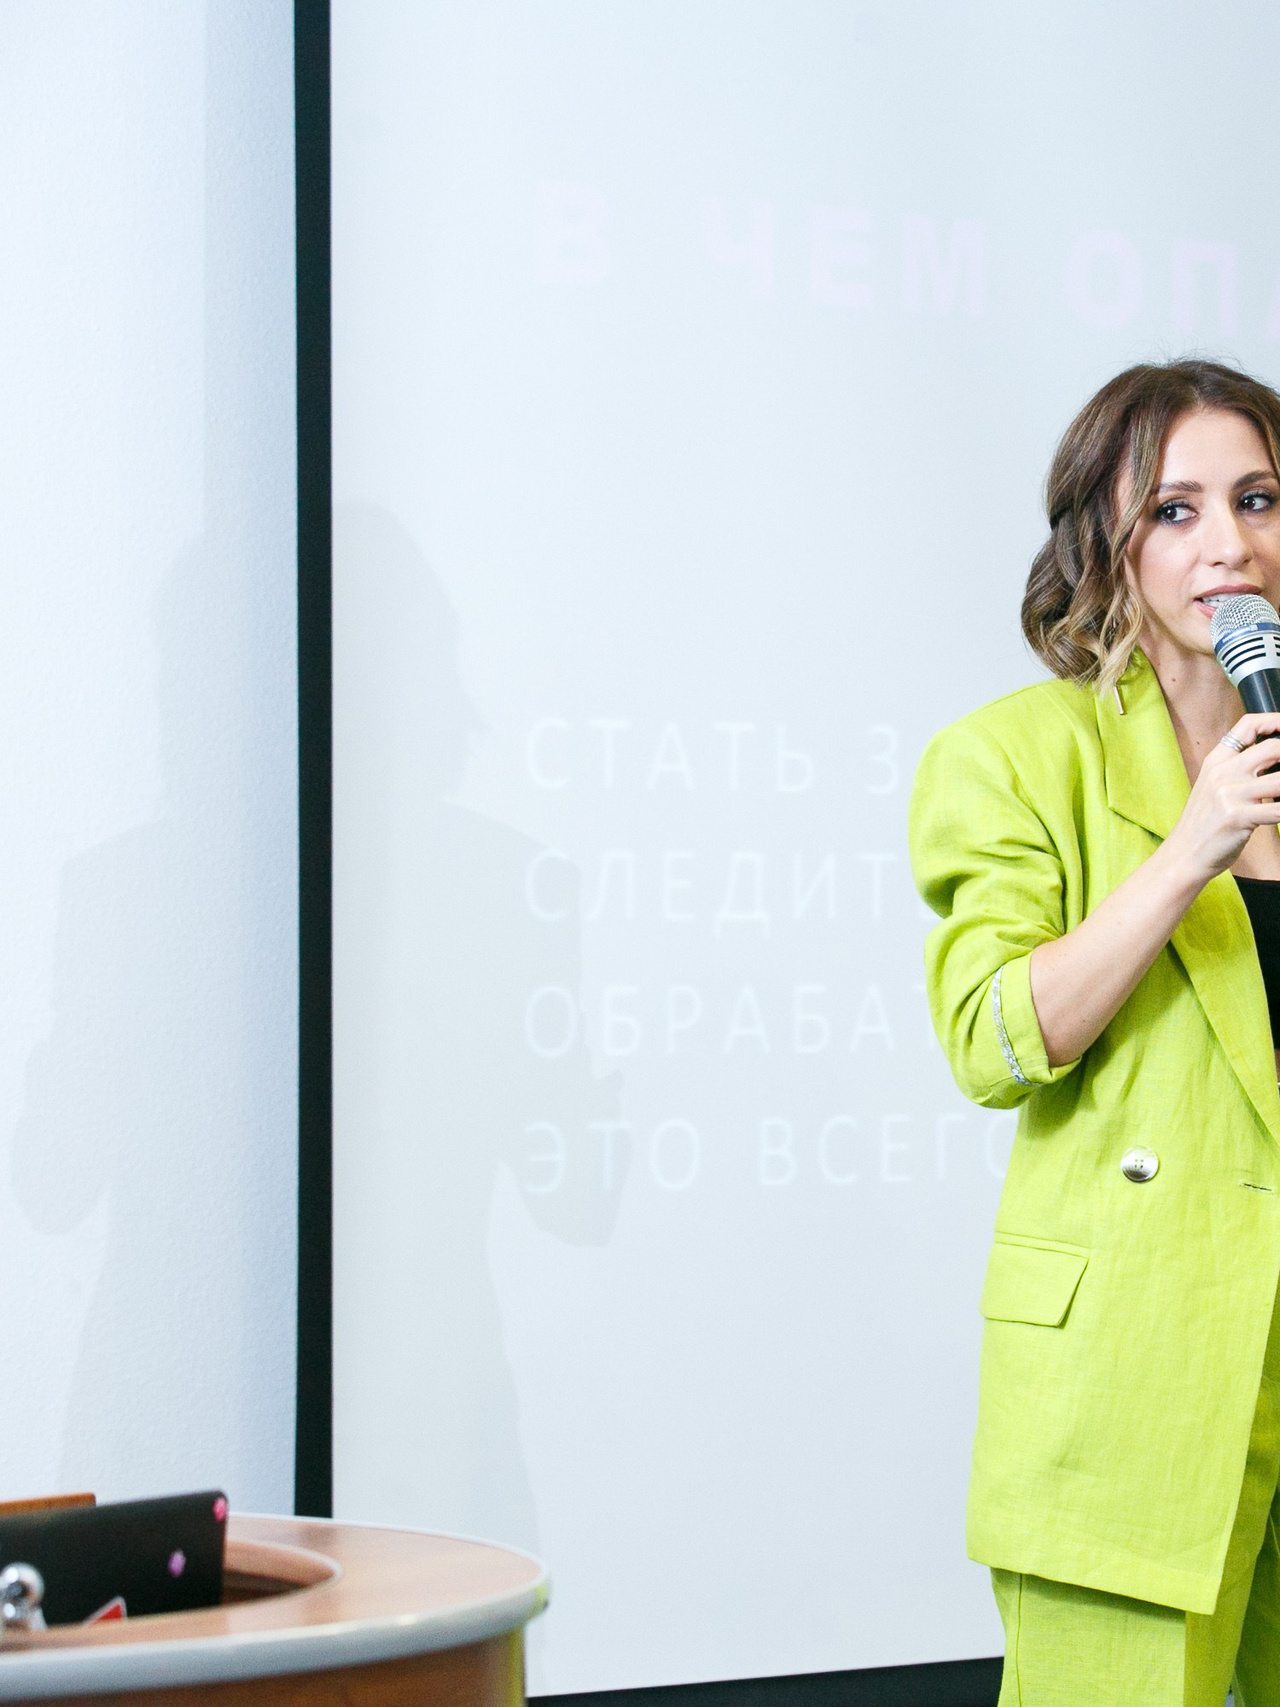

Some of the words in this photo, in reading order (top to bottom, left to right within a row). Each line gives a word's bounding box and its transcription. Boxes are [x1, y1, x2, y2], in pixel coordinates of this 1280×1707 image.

[538, 180, 610, 286] В
[703, 197, 987, 318] ЧЕМ
[526, 717, 814, 795] СТАТЬ
[525, 847, 938, 940] СЛЕДИТ
[524, 1115, 700, 1195] ЭТО
